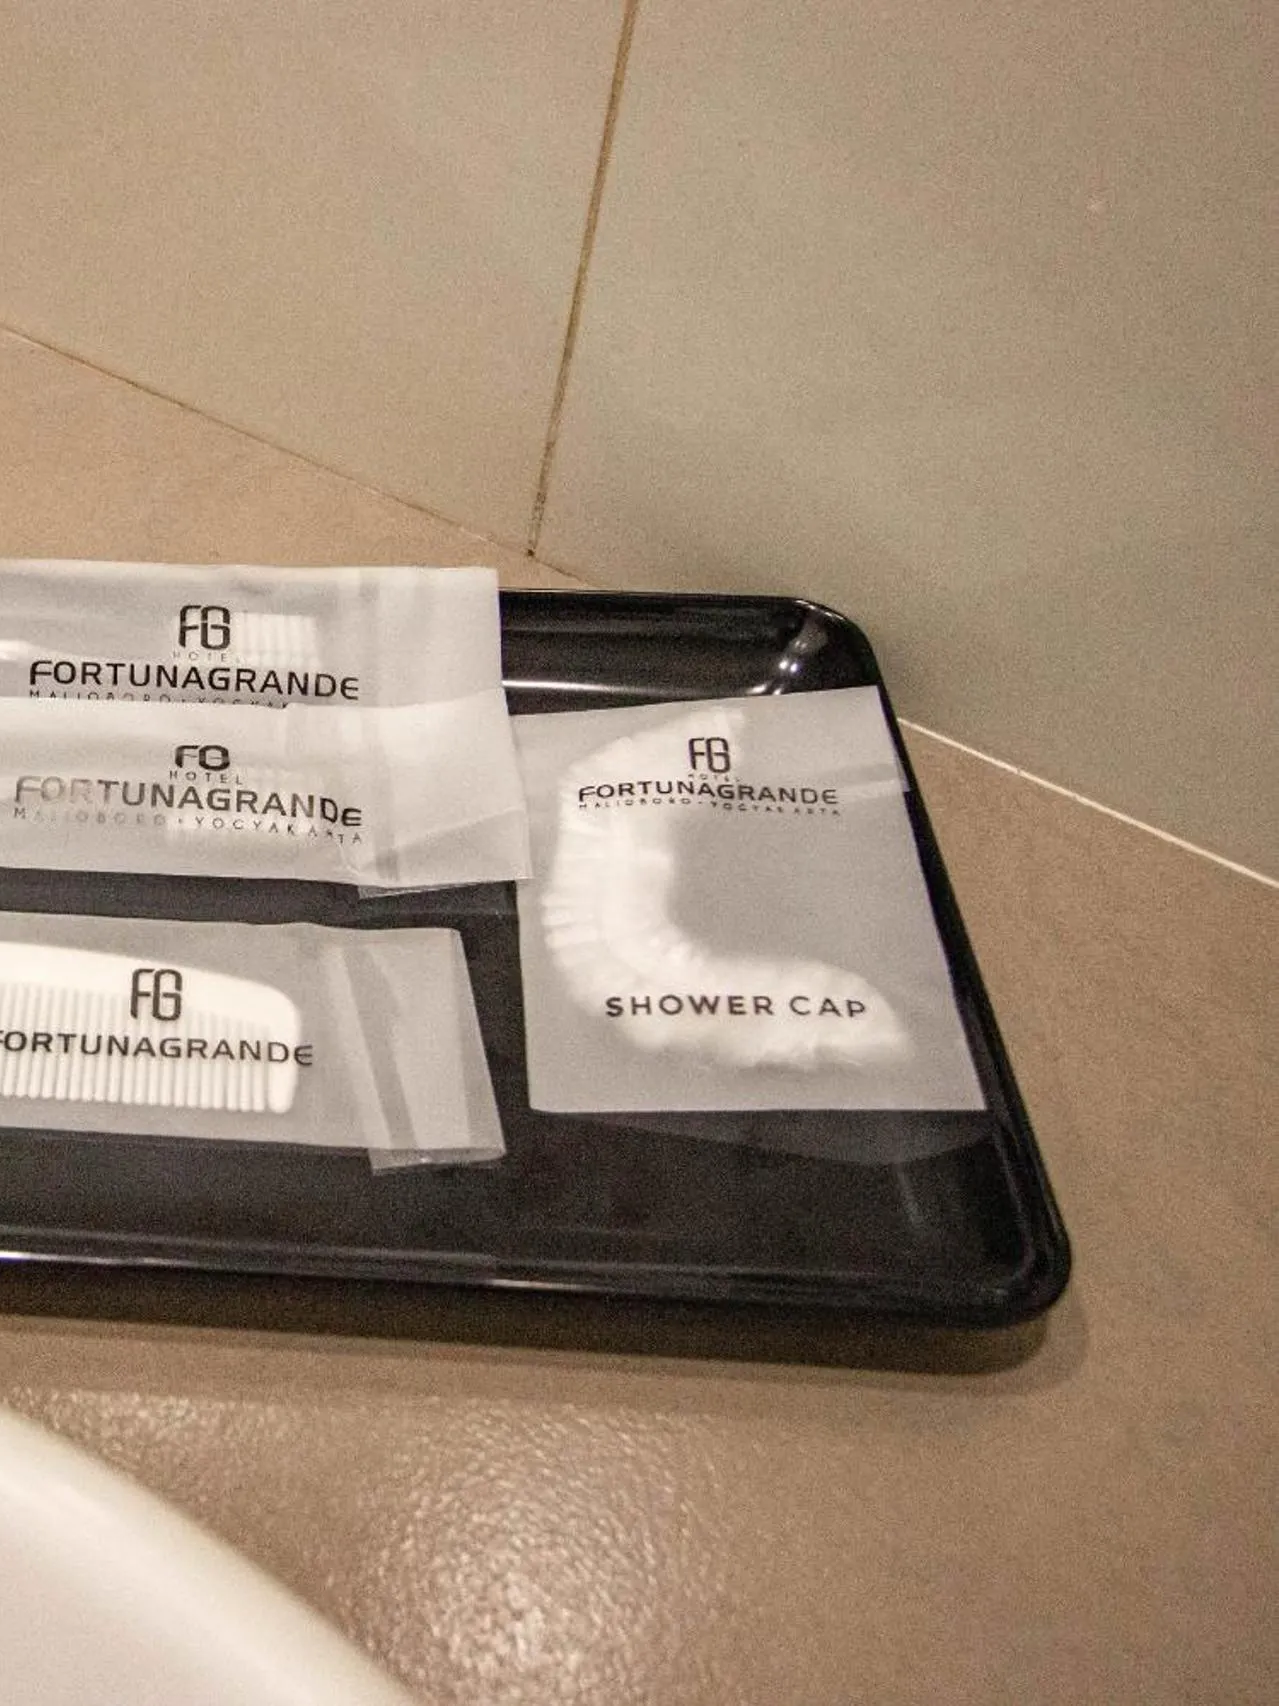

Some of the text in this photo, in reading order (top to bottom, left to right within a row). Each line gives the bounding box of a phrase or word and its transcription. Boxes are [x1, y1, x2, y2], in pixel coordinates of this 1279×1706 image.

[29, 659, 360, 701] FORTUNAGRANDE
[169, 770, 243, 786] HOTEL
[14, 775, 363, 827] FORTUNAGRANDE
[578, 780, 839, 805] FORTUNAGRANDE
[605, 994, 866, 1018] SHOWER CAP
